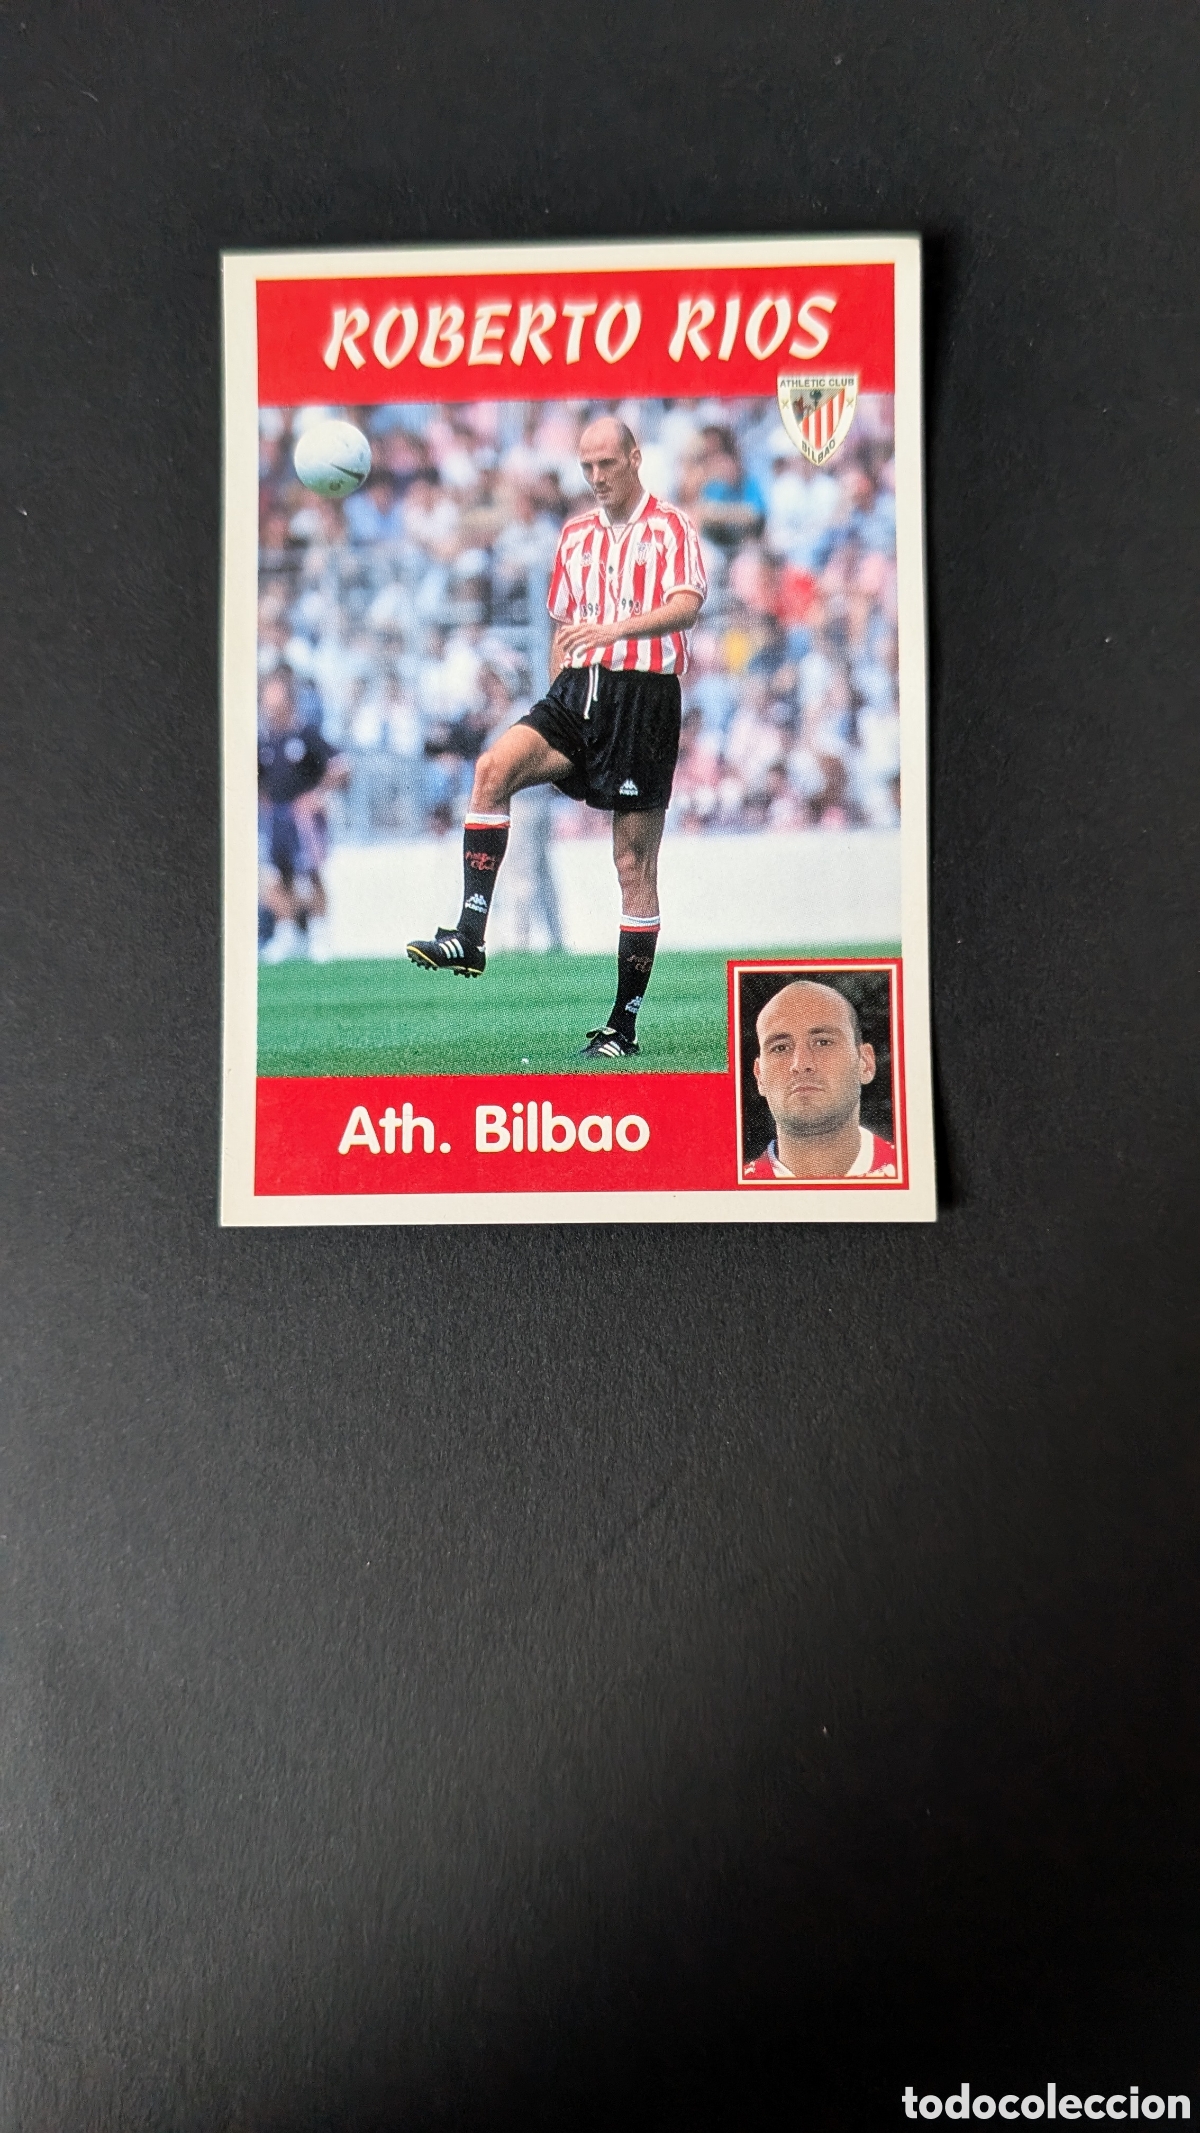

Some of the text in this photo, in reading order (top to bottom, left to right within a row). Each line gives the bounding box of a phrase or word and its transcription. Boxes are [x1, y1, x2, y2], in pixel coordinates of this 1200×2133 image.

[322, 294, 838, 371] ROBERTO RIOS
[780, 378, 855, 388] ATHLETIC CLUB
[801, 439, 836, 465] BILBAO
[337, 1100, 651, 1155] Ath. Bilbao
